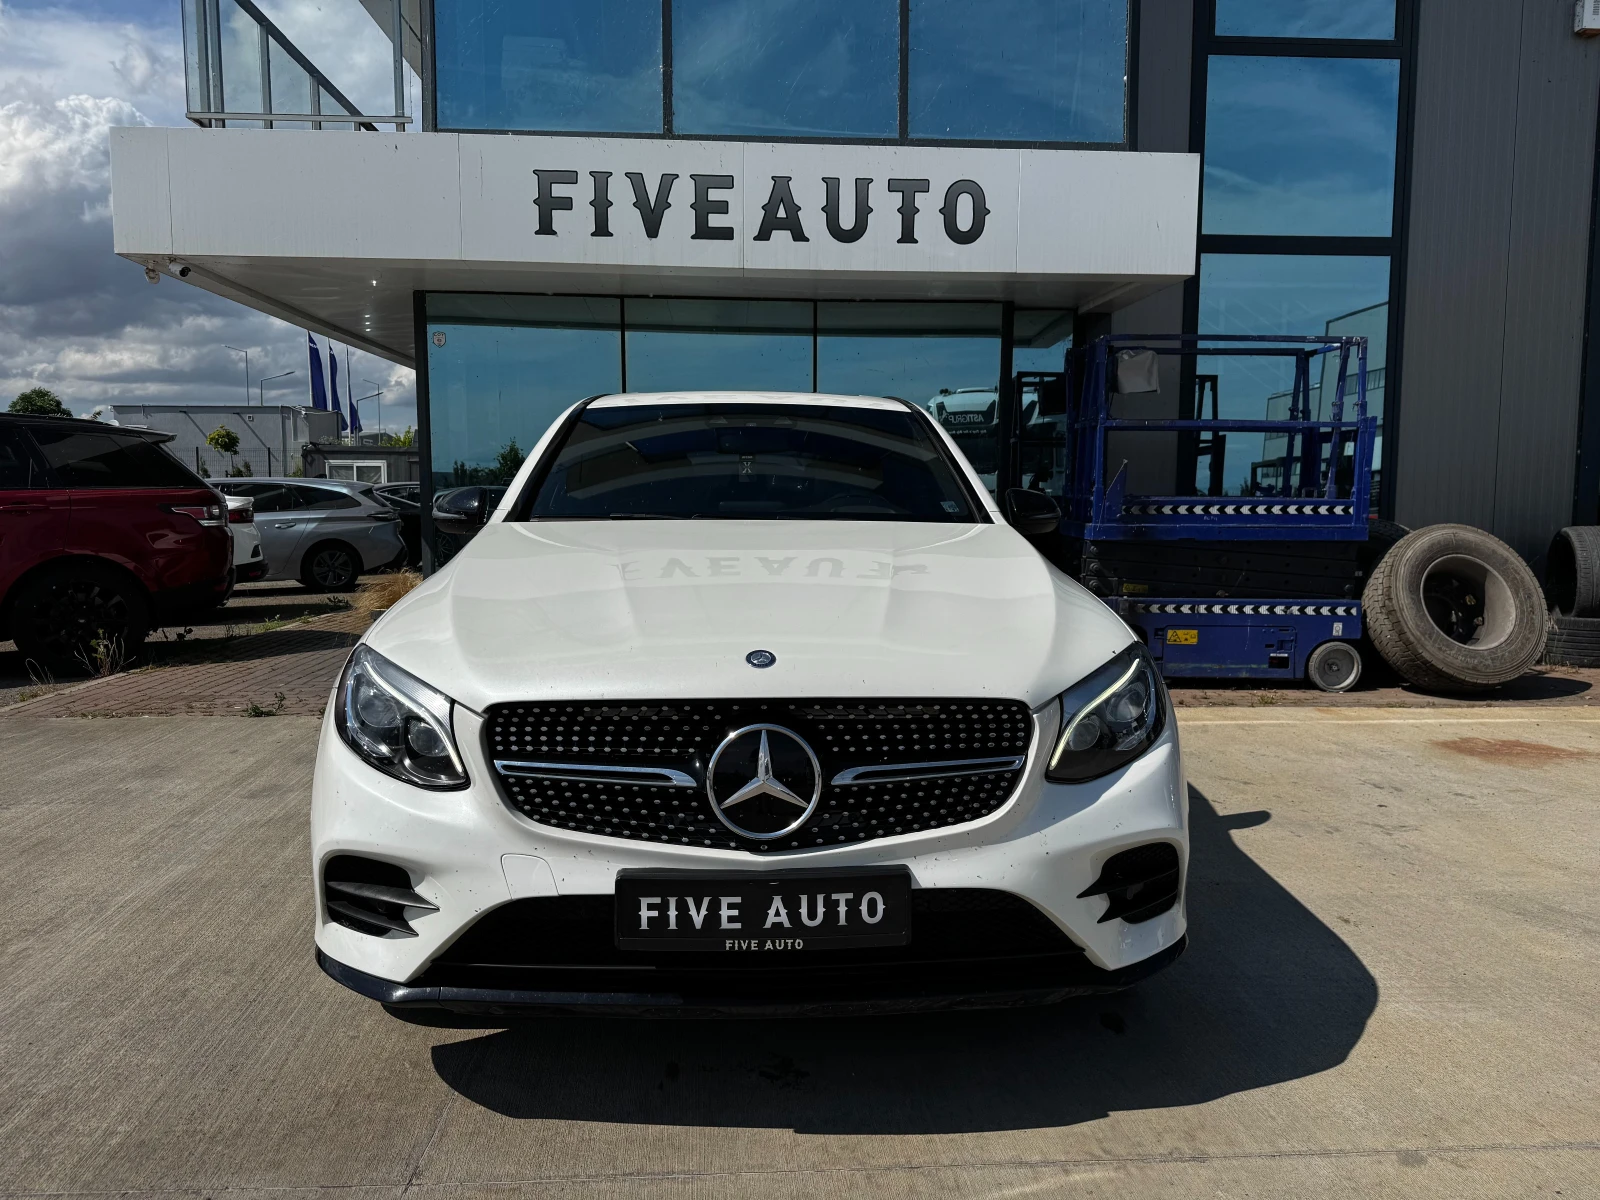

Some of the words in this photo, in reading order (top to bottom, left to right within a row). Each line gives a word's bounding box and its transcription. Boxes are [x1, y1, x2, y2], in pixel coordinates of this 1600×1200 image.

[638, 896, 742, 930] FIVE
[762, 891, 887, 929] AUTO
[725, 939, 759, 951] FIVE
[764, 938, 804, 950] AUTO
